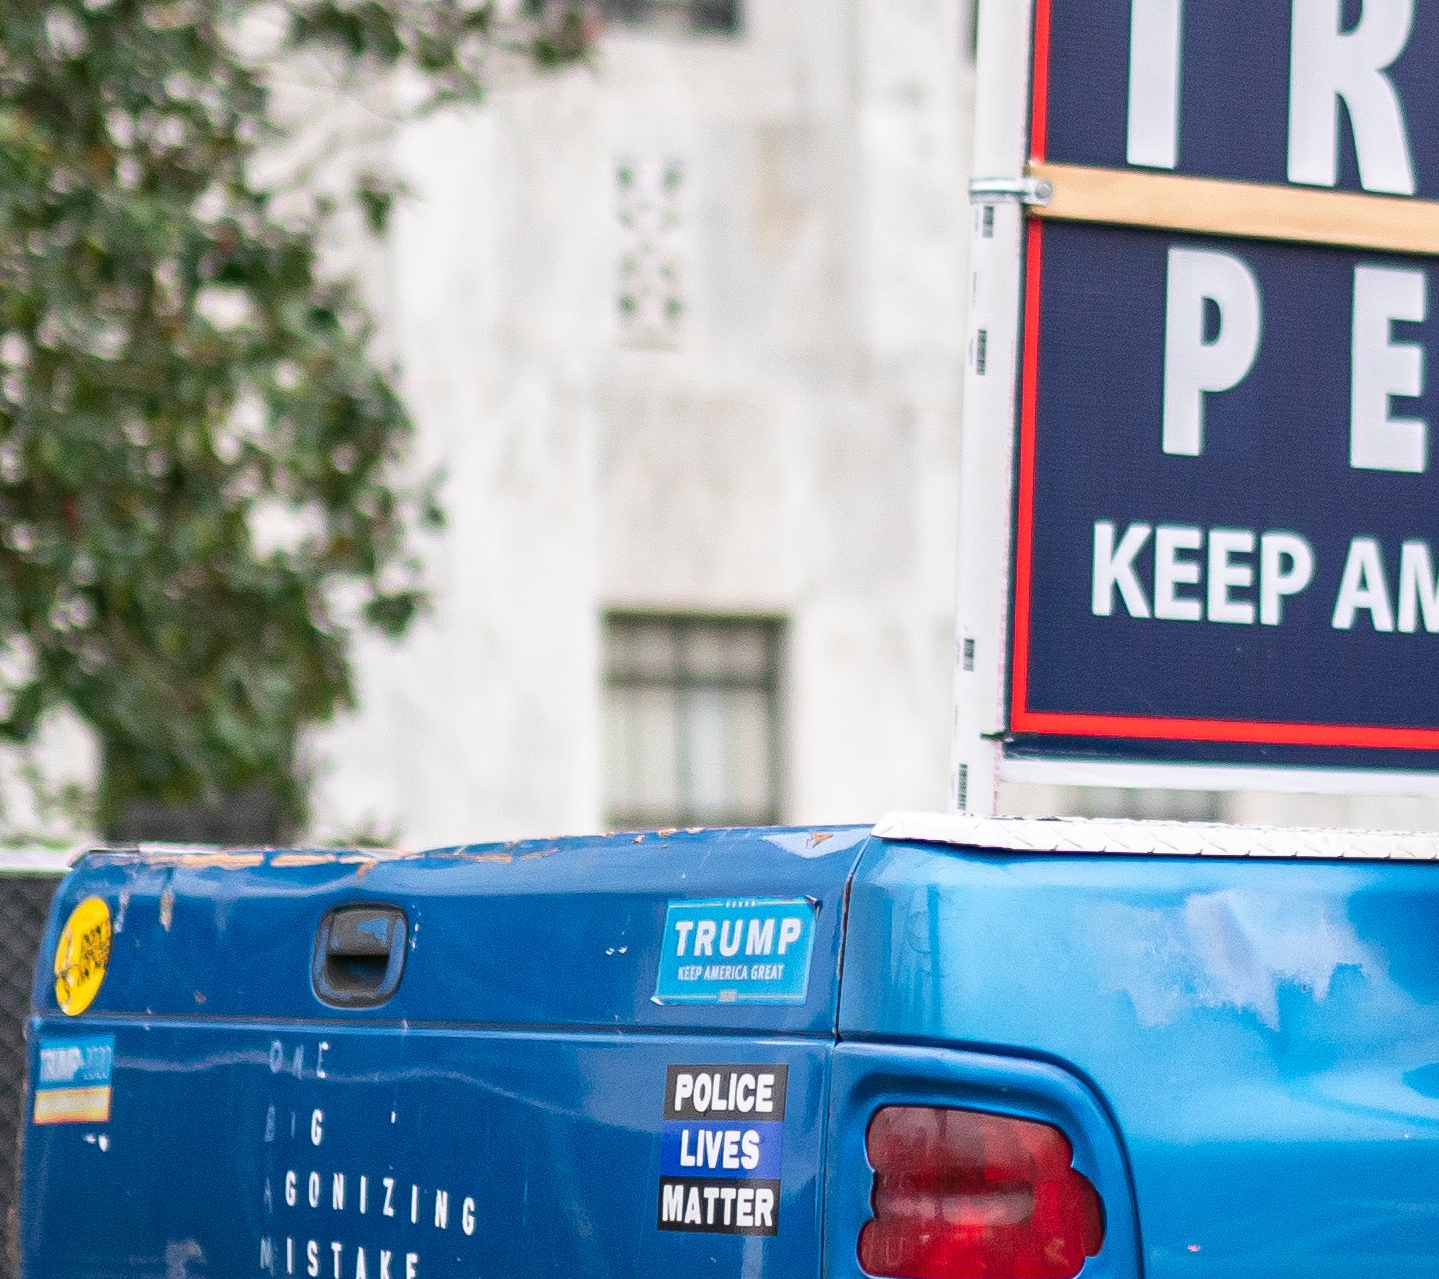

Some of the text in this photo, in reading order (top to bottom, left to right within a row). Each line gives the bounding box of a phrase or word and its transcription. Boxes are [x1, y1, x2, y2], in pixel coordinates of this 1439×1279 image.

[1091, 519, 1316, 627] KEEP
[675, 918, 803, 957] TRUMP
[678, 964, 785, 981] KEEP AMERICA GREAT
[674, 1073, 775, 1112] POLICE
[680, 1129, 760, 1169] LIVES
[662, 1184, 774, 1227] MATTER
